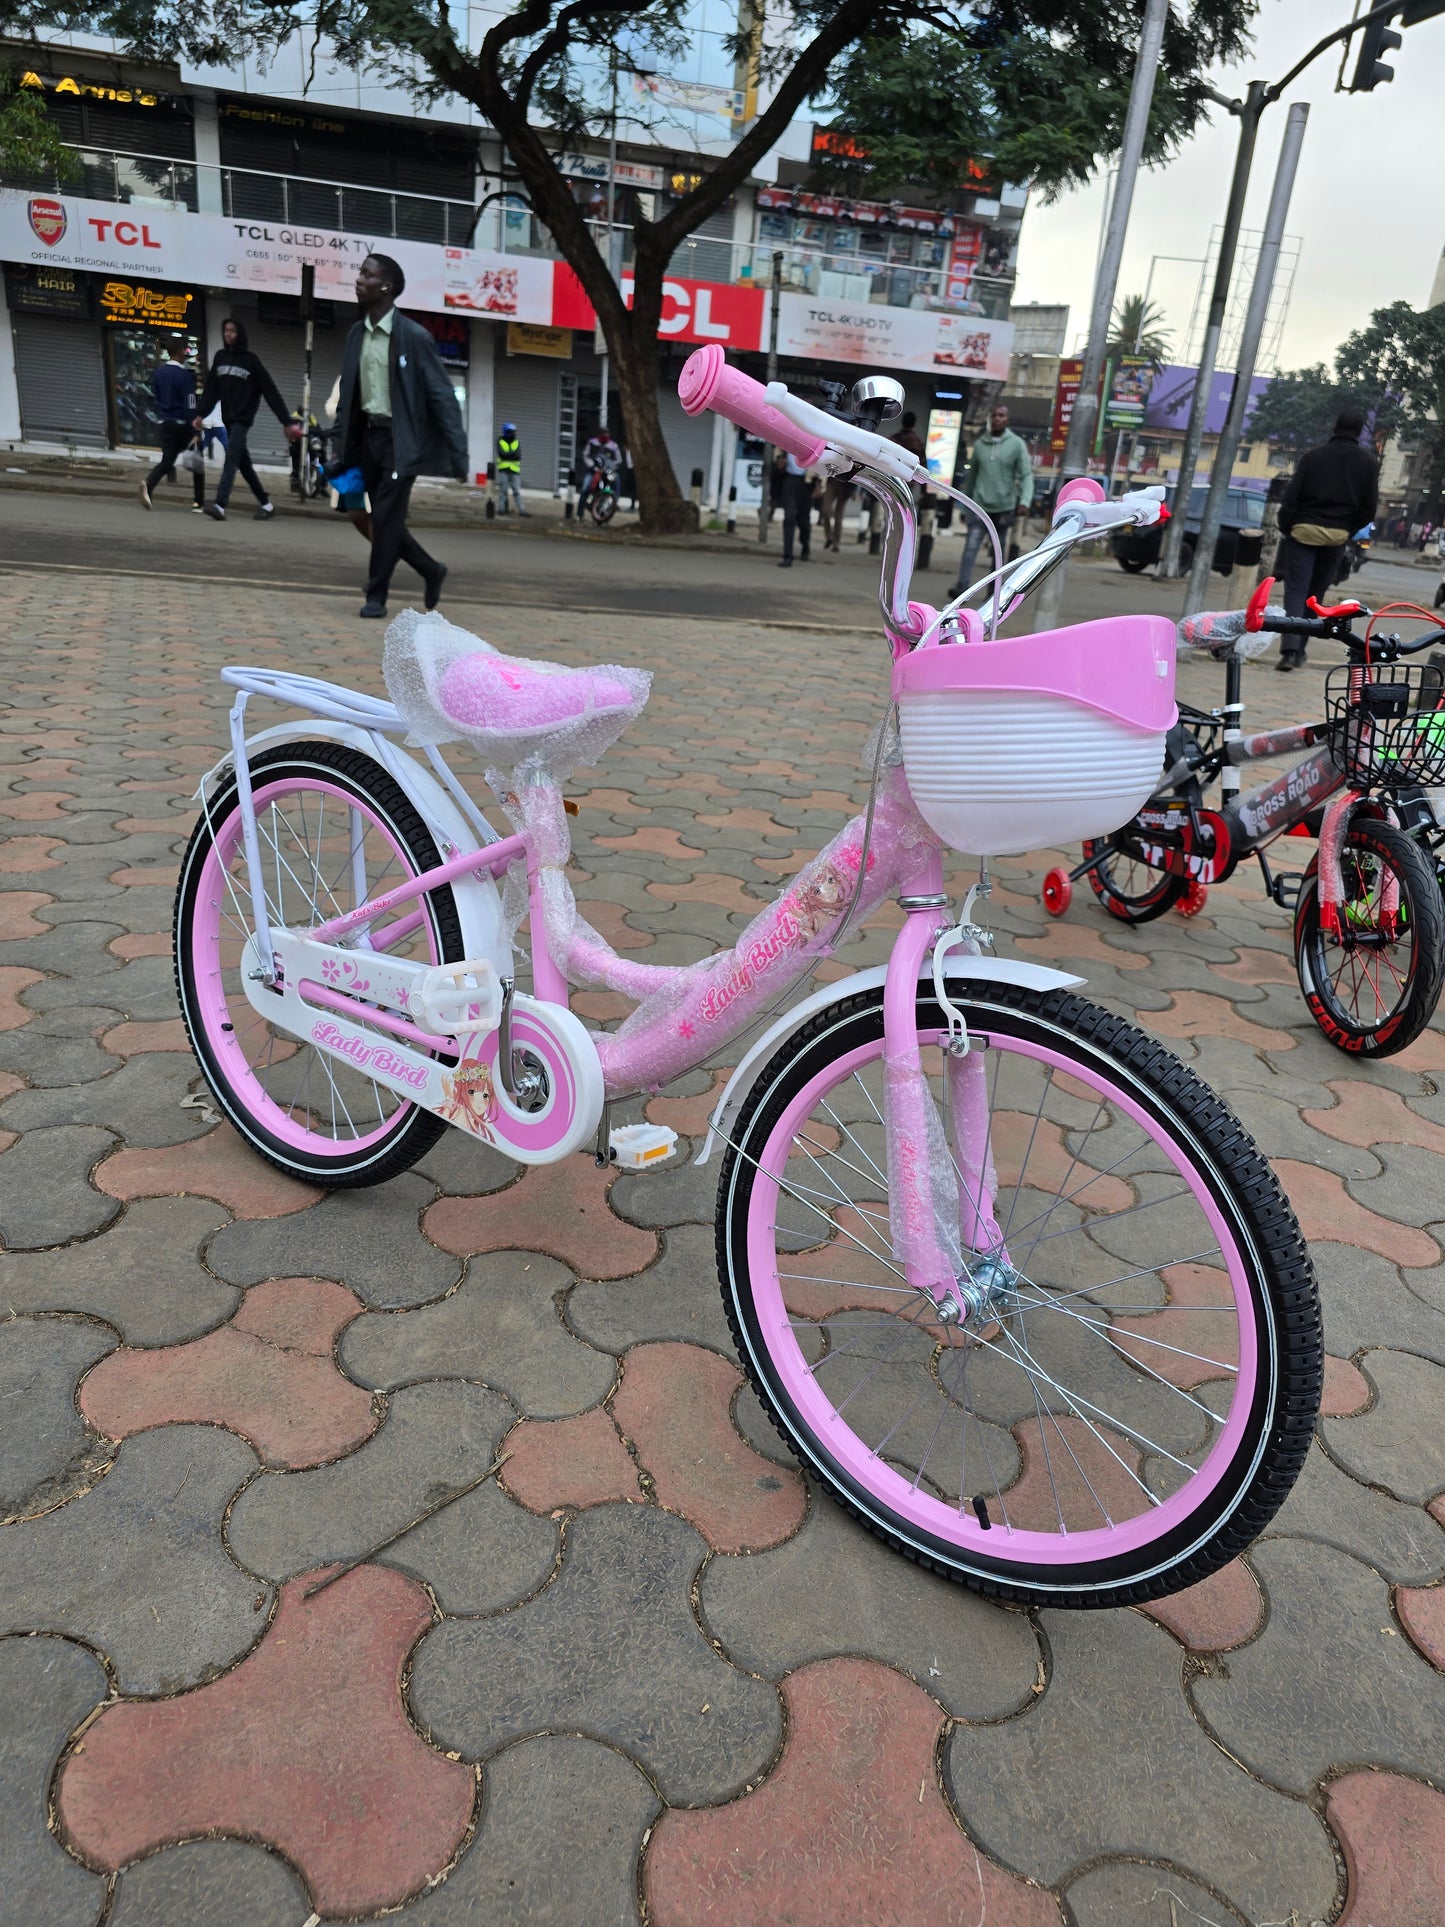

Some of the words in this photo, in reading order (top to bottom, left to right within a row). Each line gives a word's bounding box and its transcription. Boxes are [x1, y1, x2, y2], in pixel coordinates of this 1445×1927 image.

[224, 104, 305, 128] Fashion
[312, 117, 346, 134] line
[32, 205, 63, 217] Arsenal
[88, 217, 162, 249] TCL
[234, 224, 275, 242] TCL
[280, 230, 325, 249] QLED
[329, 237, 349, 253] 4K
[353, 240, 375, 255] TV
[31, 251, 73, 264] OFFICIAL
[74, 256, 121, 270] REGIONAL
[122, 262, 164, 274] PARTNER
[37, 278, 76, 292] HAIR
[619, 278, 731, 340] CL
[808, 310, 836, 323] TCL
[1248, 790, 1286, 826] CROSS
[1287, 767, 1320, 801] ROAD
[1140, 811, 1165, 825] CROSS
[1164, 813, 1189, 827] ROAD
[700, 955, 756, 1024] Lady
[748, 912, 801, 976] Bird
[311, 1021, 374, 1067] Lady
[372, 1048, 431, 1091] Bird
